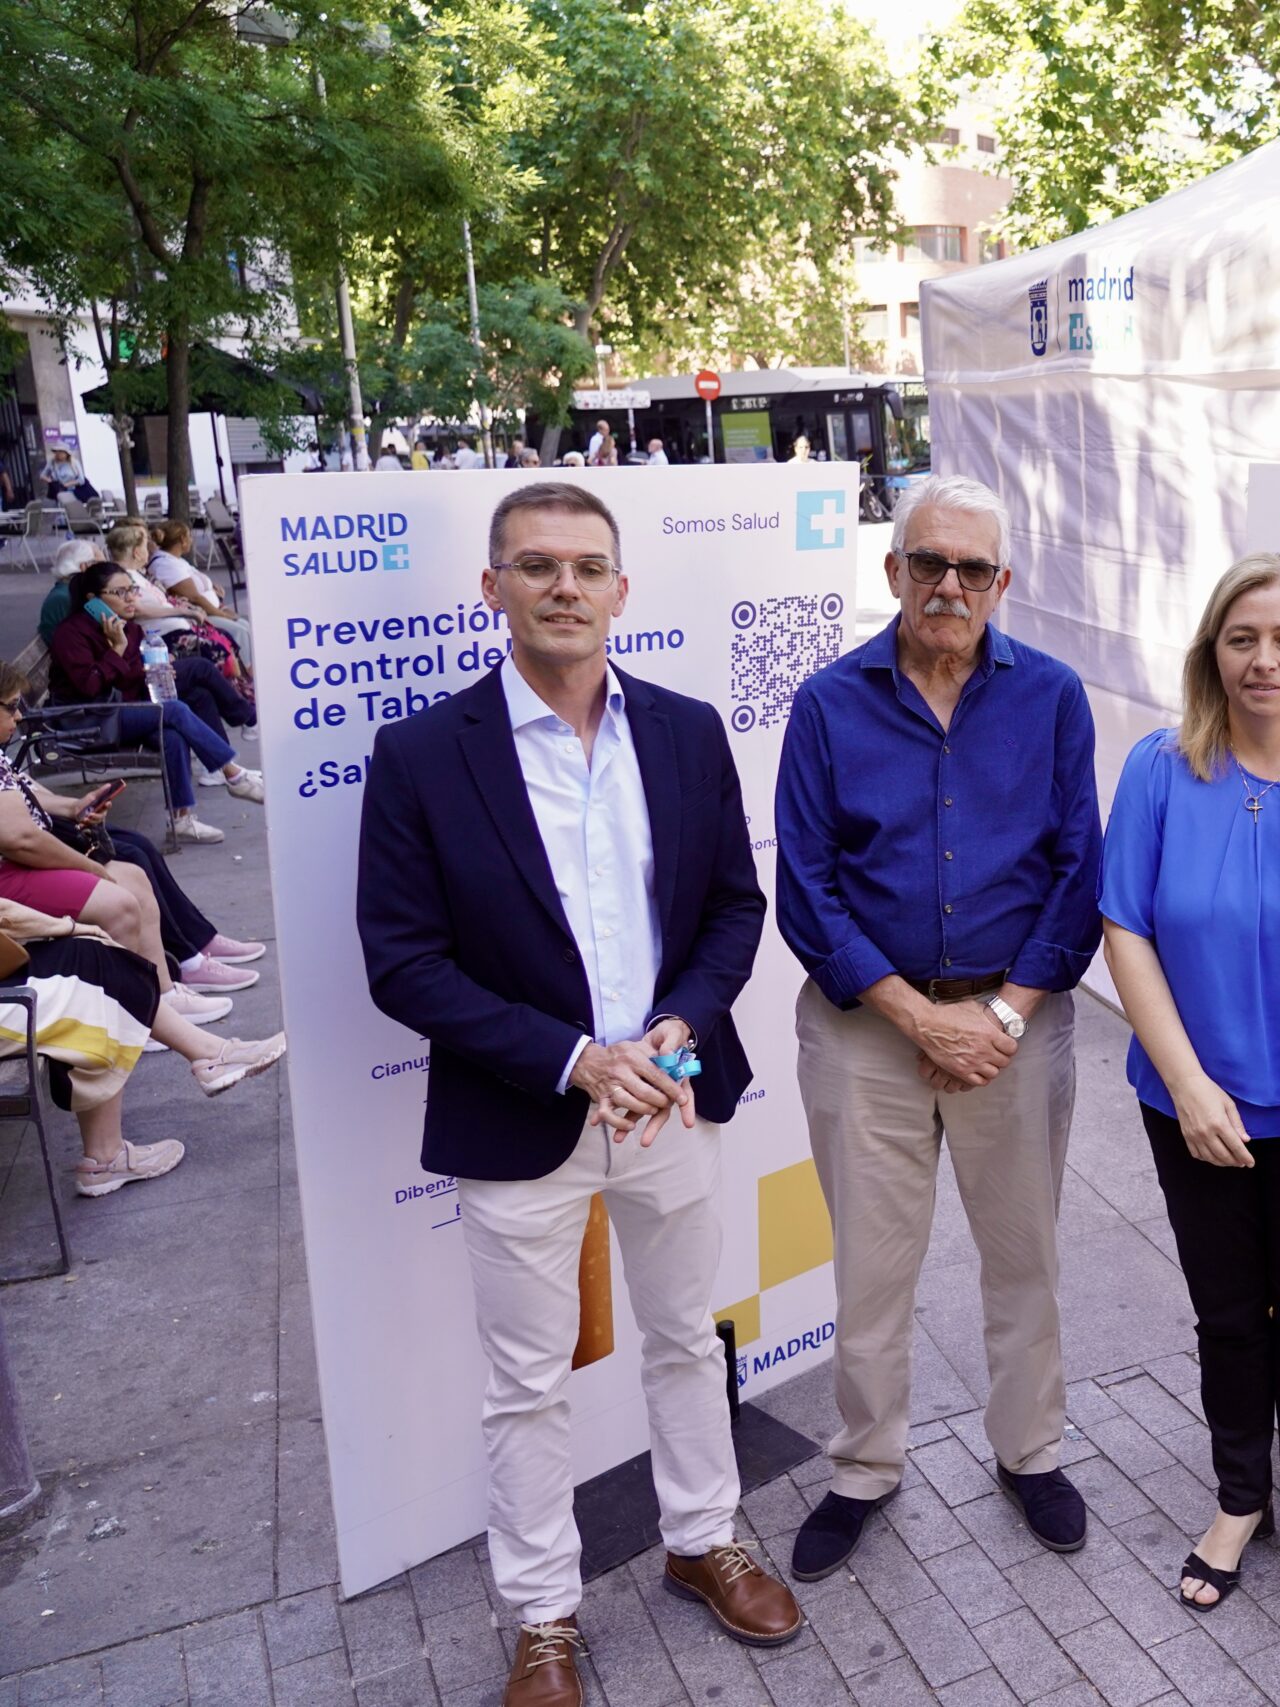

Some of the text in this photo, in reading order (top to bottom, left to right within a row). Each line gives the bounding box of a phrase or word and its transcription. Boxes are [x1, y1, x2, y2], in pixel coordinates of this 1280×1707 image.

[1069, 266, 1135, 302] madrid
[280, 512, 408, 543] MADRID
[662, 511, 780, 535] Somos Salud
[283, 549, 378, 577] SALUD
[289, 644, 446, 690] Control
[293, 697, 346, 730] de
[753, 1321, 835, 1376] MADRID
